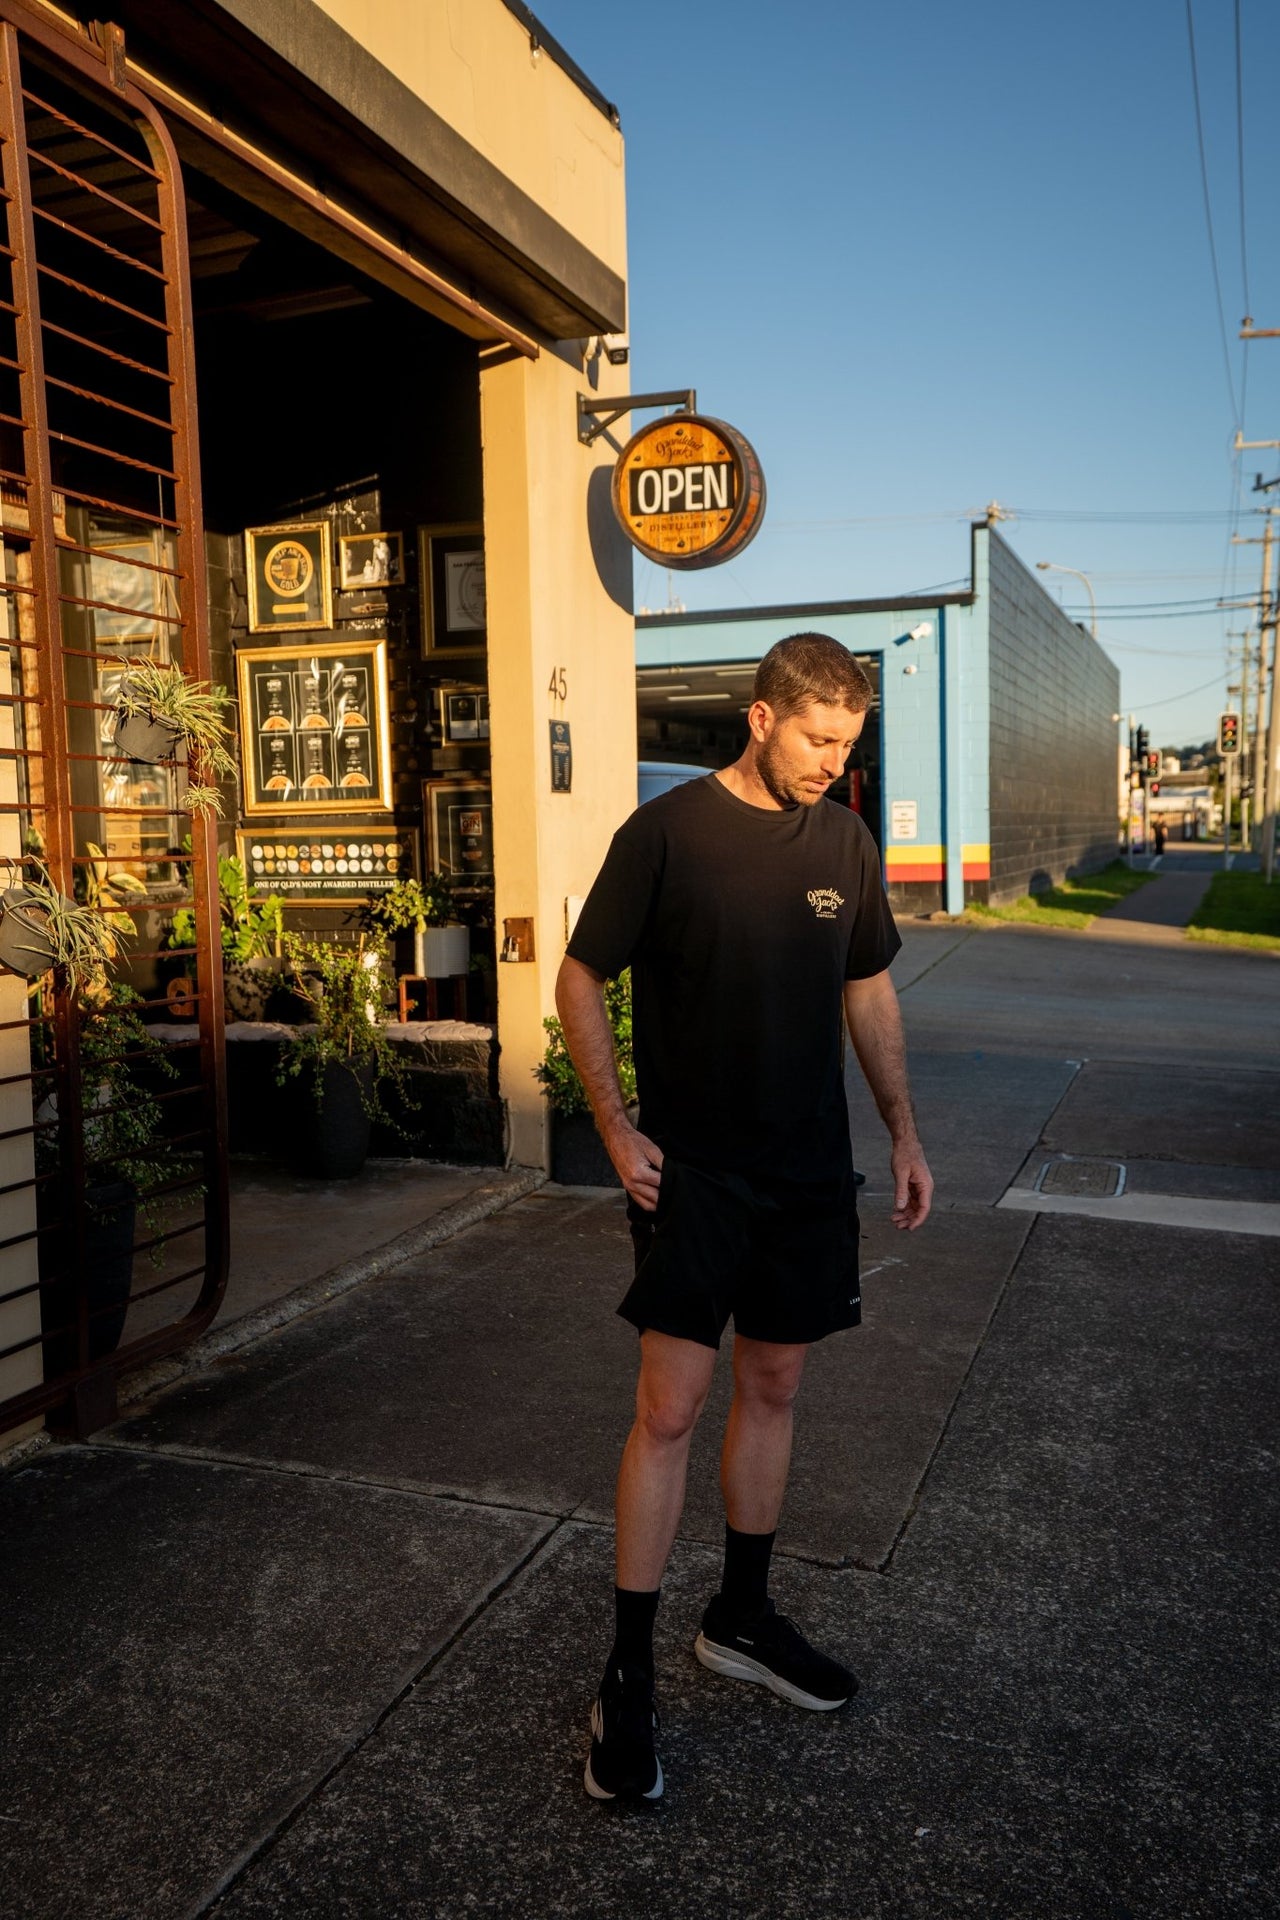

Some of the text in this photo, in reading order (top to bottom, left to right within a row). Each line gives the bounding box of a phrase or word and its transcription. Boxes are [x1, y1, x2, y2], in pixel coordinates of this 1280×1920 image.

[637, 463, 728, 514] OPEN
[649, 520, 714, 532] DISTILLERY
[279, 579, 300, 590] GOLD
[548, 666, 567, 700] 45
[462, 819, 481, 829] GIN
[254, 880, 397, 890] ONE OF QLD'S MOST AWARDED DISTILLER
